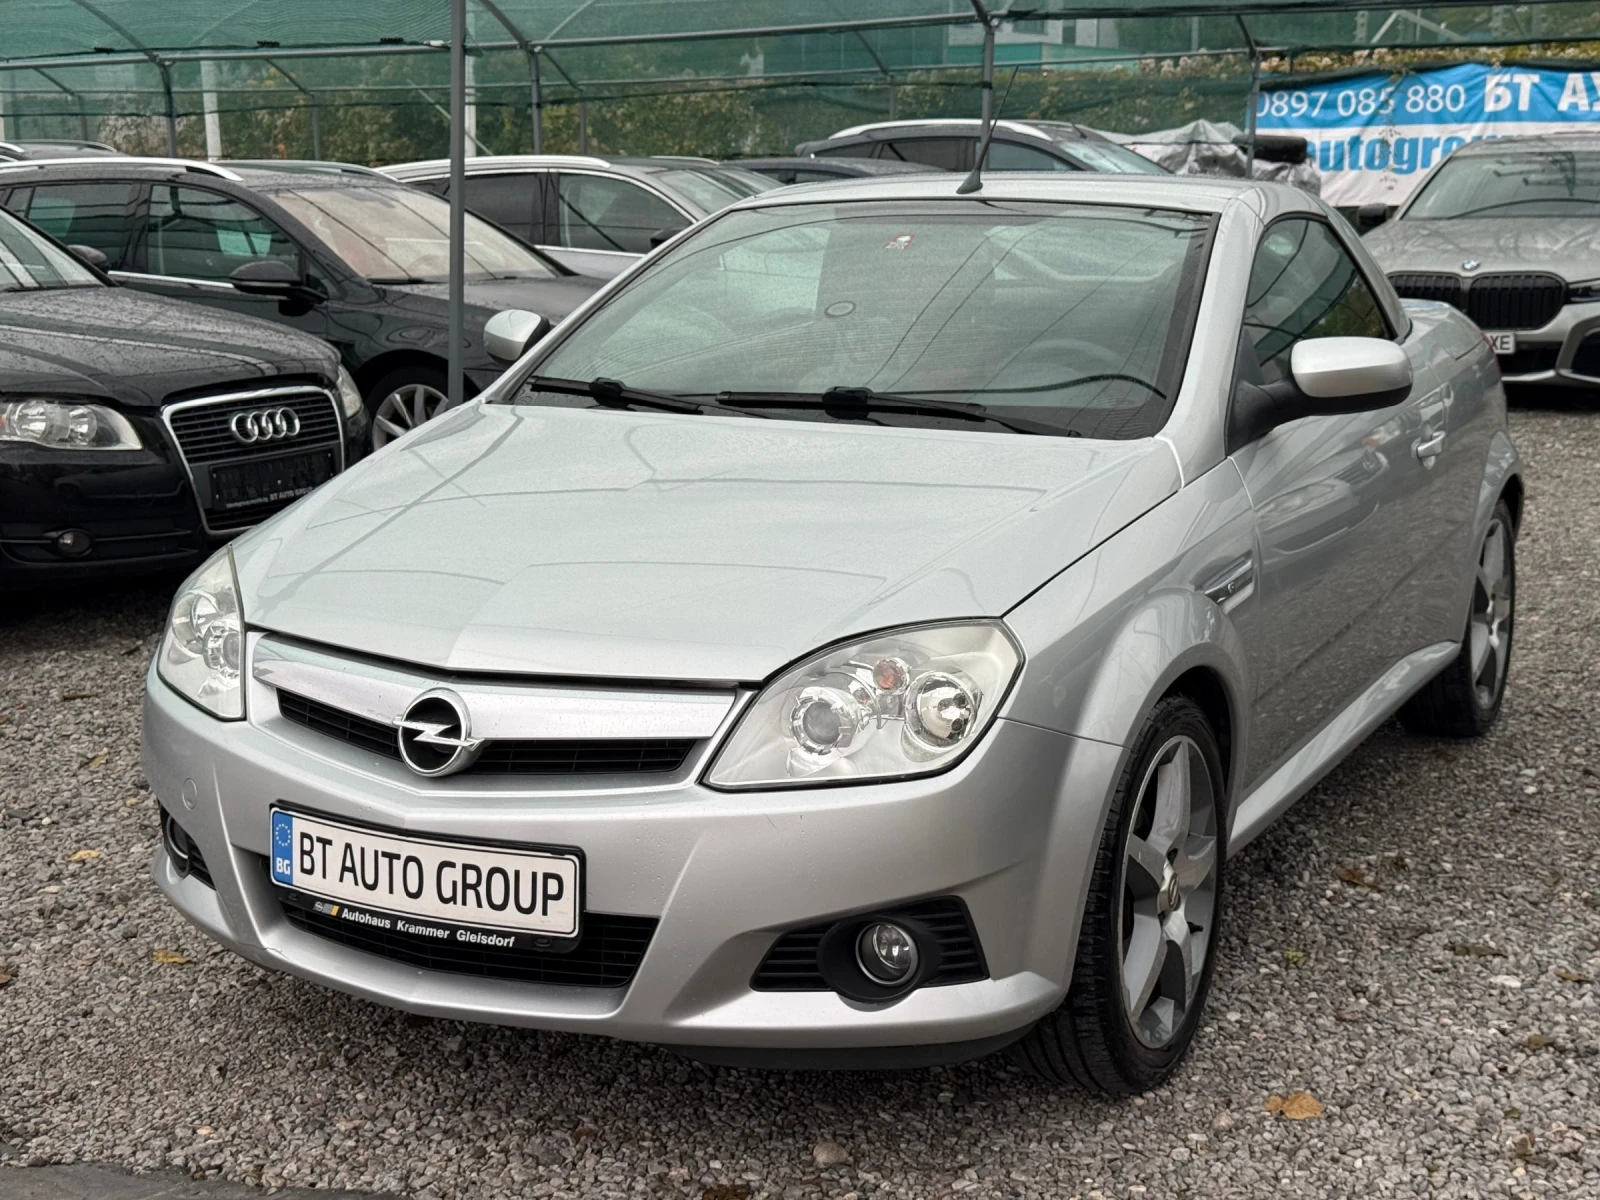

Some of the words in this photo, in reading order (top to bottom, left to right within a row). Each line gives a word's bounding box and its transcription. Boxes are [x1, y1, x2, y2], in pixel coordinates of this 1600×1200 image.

[1256, 90, 1328, 117] 0897
[1337, 87, 1395, 117] 085
[1405, 84, 1466, 113] 880
[1484, 73, 1540, 113] БТ
[275, 857, 291, 875] BG
[300, 831, 333, 880] BT
[338, 841, 425, 900] AUTO
[436, 860, 564, 917] GROUP
[341, 907, 391, 929] Autohaus
[396, 920, 451, 940] Krammer
[456, 929, 516, 948] Gleisdorf
